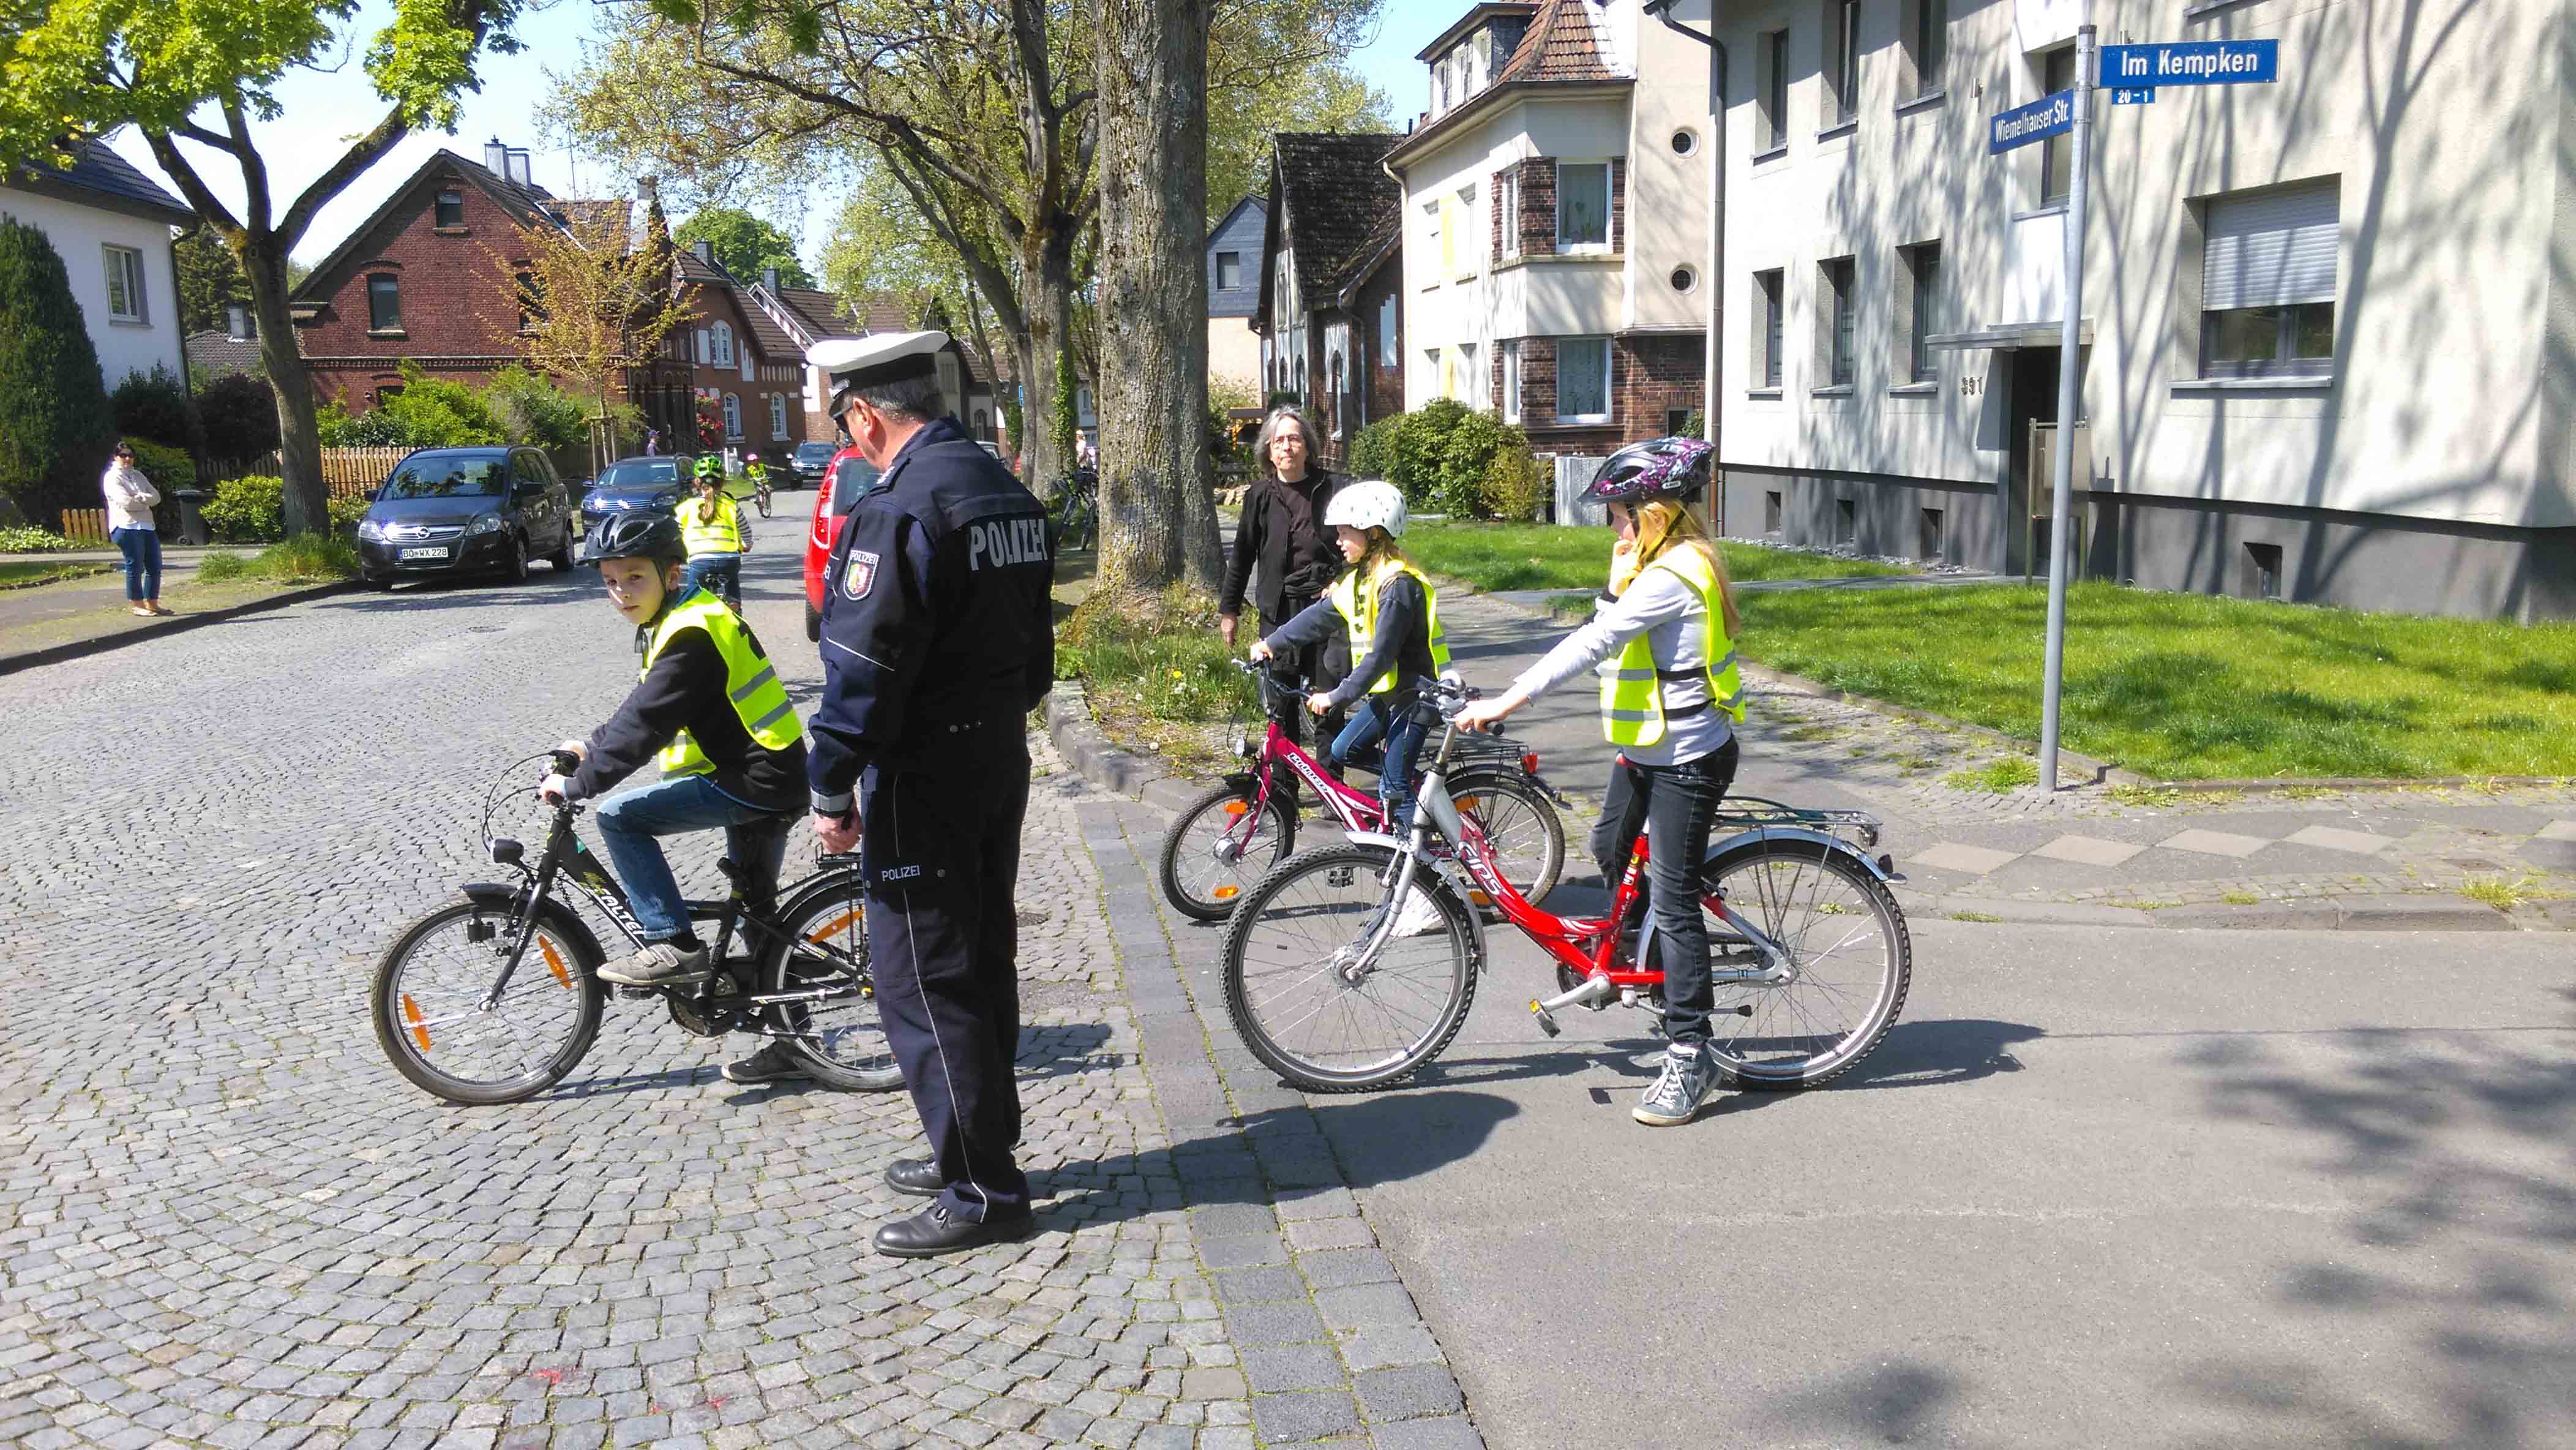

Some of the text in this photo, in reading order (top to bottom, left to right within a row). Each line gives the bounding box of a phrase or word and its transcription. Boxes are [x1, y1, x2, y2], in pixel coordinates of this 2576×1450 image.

[2121, 47, 2258, 78] Im Kempken
[2117, 90, 2131, 103] 20
[2143, 90, 2148, 103] 1
[1996, 100, 2069, 142] Wiemelhauser Str.
[432, 548, 447, 557] 228
[970, 519, 1049, 571] POLIZEI
[851, 552, 877, 565] POLIZEI
[881, 865, 921, 882] POLIZEI
